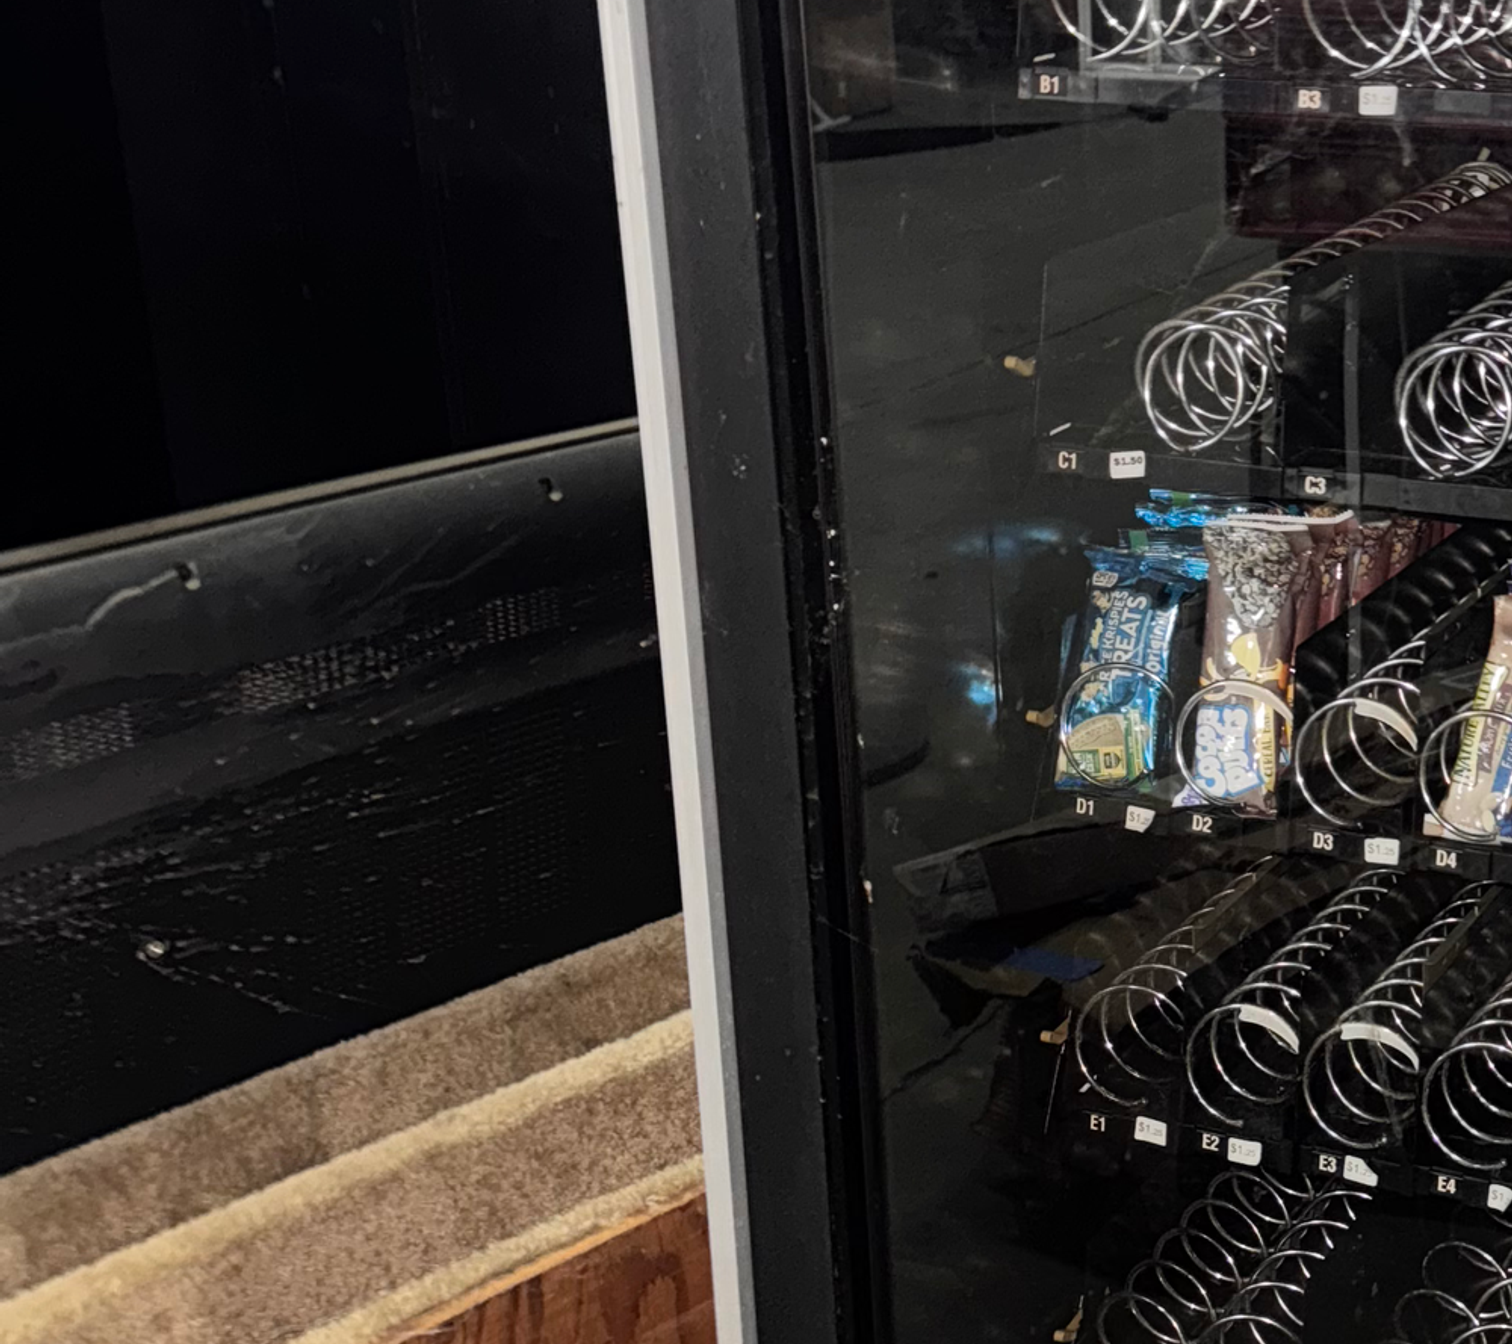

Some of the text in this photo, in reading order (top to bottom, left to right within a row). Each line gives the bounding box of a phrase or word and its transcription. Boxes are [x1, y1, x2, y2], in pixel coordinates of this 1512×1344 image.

[1038, 74, 1060, 94] B1
[1297, 88, 1323, 110] B3
[1057, 451, 1078, 470] C1
[1112, 454, 1144, 467] $1.50
[1304, 475, 1327, 494] C3
[1111, 595, 1149, 678] TREATS
[1075, 797, 1095, 816] D1
[1191, 814, 1213, 834] D2
[1312, 831, 1334, 851] D3
[1435, 849, 1458, 870] D4
[1090, 1114, 1106, 1133] E1
[1202, 1134, 1220, 1152] E2
[1318, 1156, 1337, 1173] E3
[1436, 1176, 1457, 1195] E4
